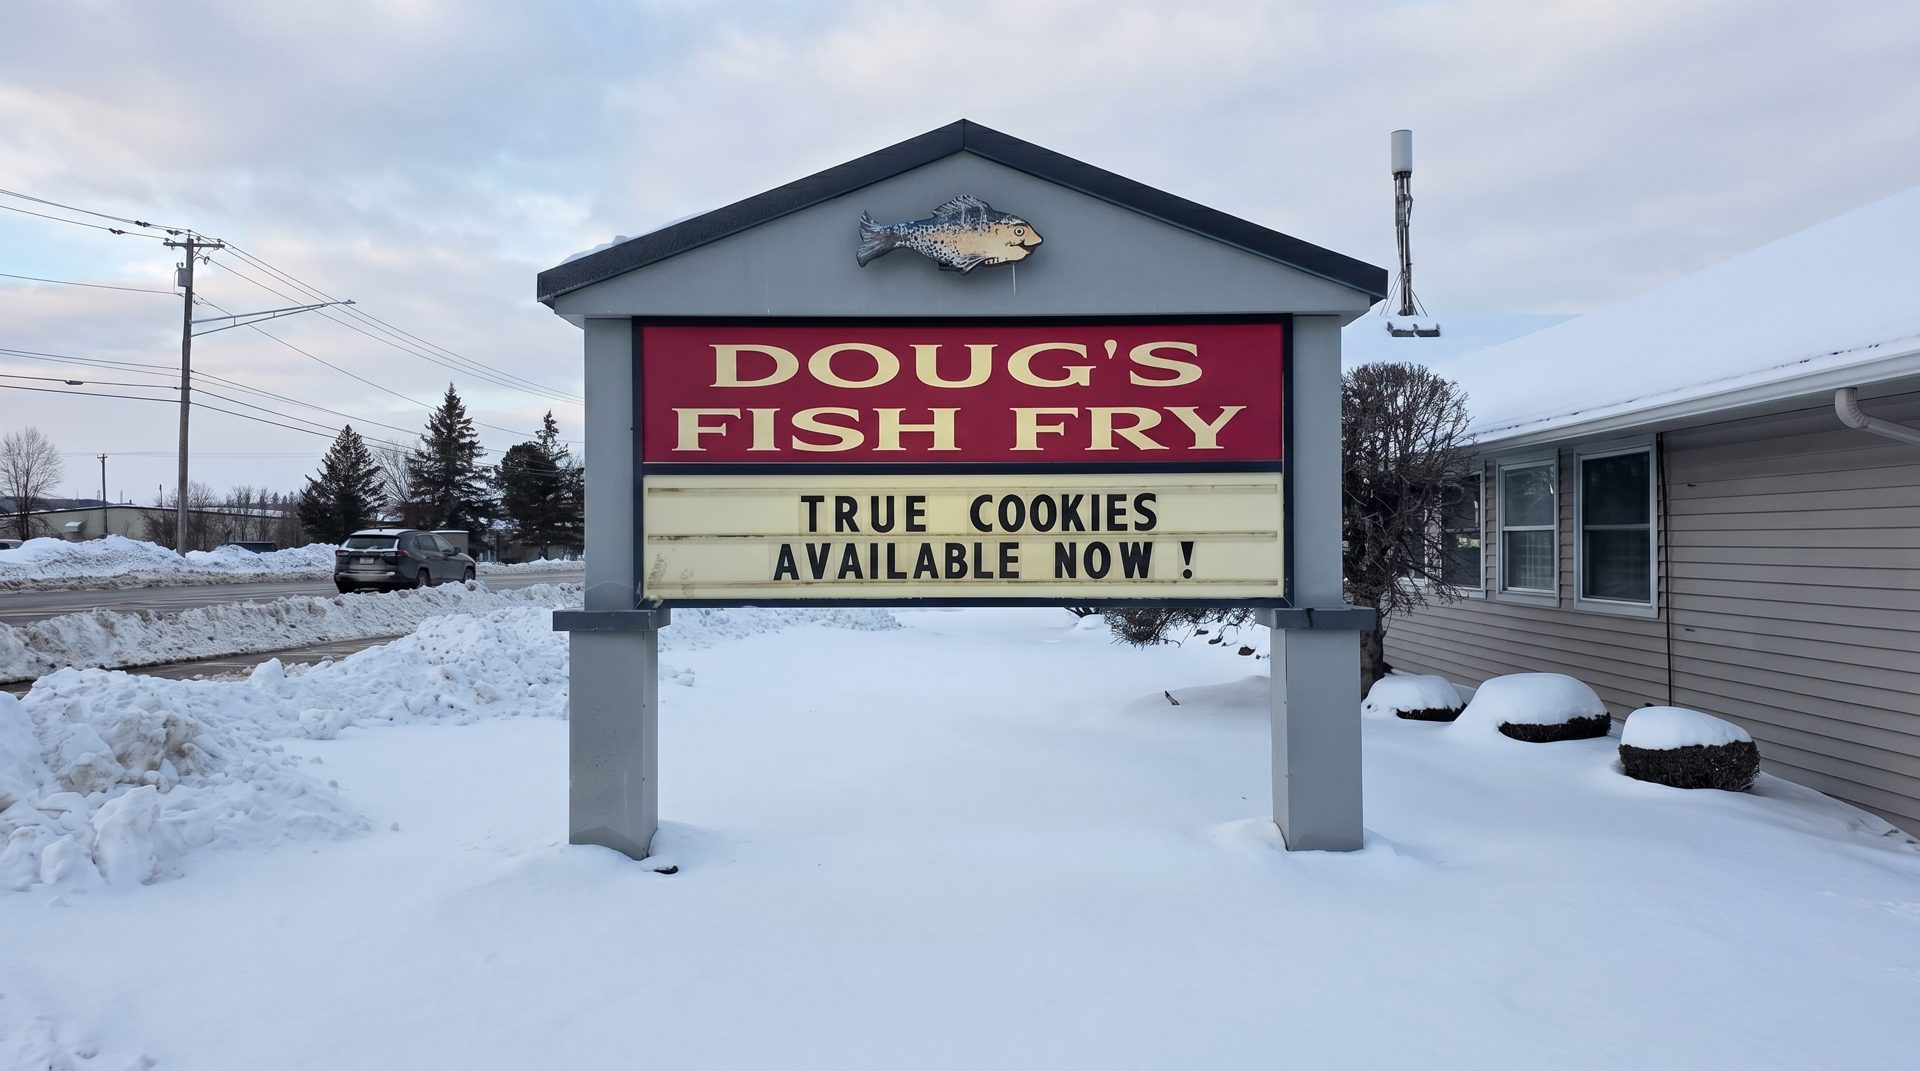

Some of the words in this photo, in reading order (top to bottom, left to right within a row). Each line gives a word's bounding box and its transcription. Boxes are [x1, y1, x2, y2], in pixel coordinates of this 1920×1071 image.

[709, 340, 1204, 389] DOUG'S
[672, 407, 963, 453] FISH
[1010, 406, 1248, 452] FRY
[801, 495, 928, 533] TRUE
[970, 492, 1158, 532] COOKIES
[774, 543, 1021, 581] AVAILABLE
[1055, 541, 1154, 580] NOW
[1181, 541, 1196, 580] !
